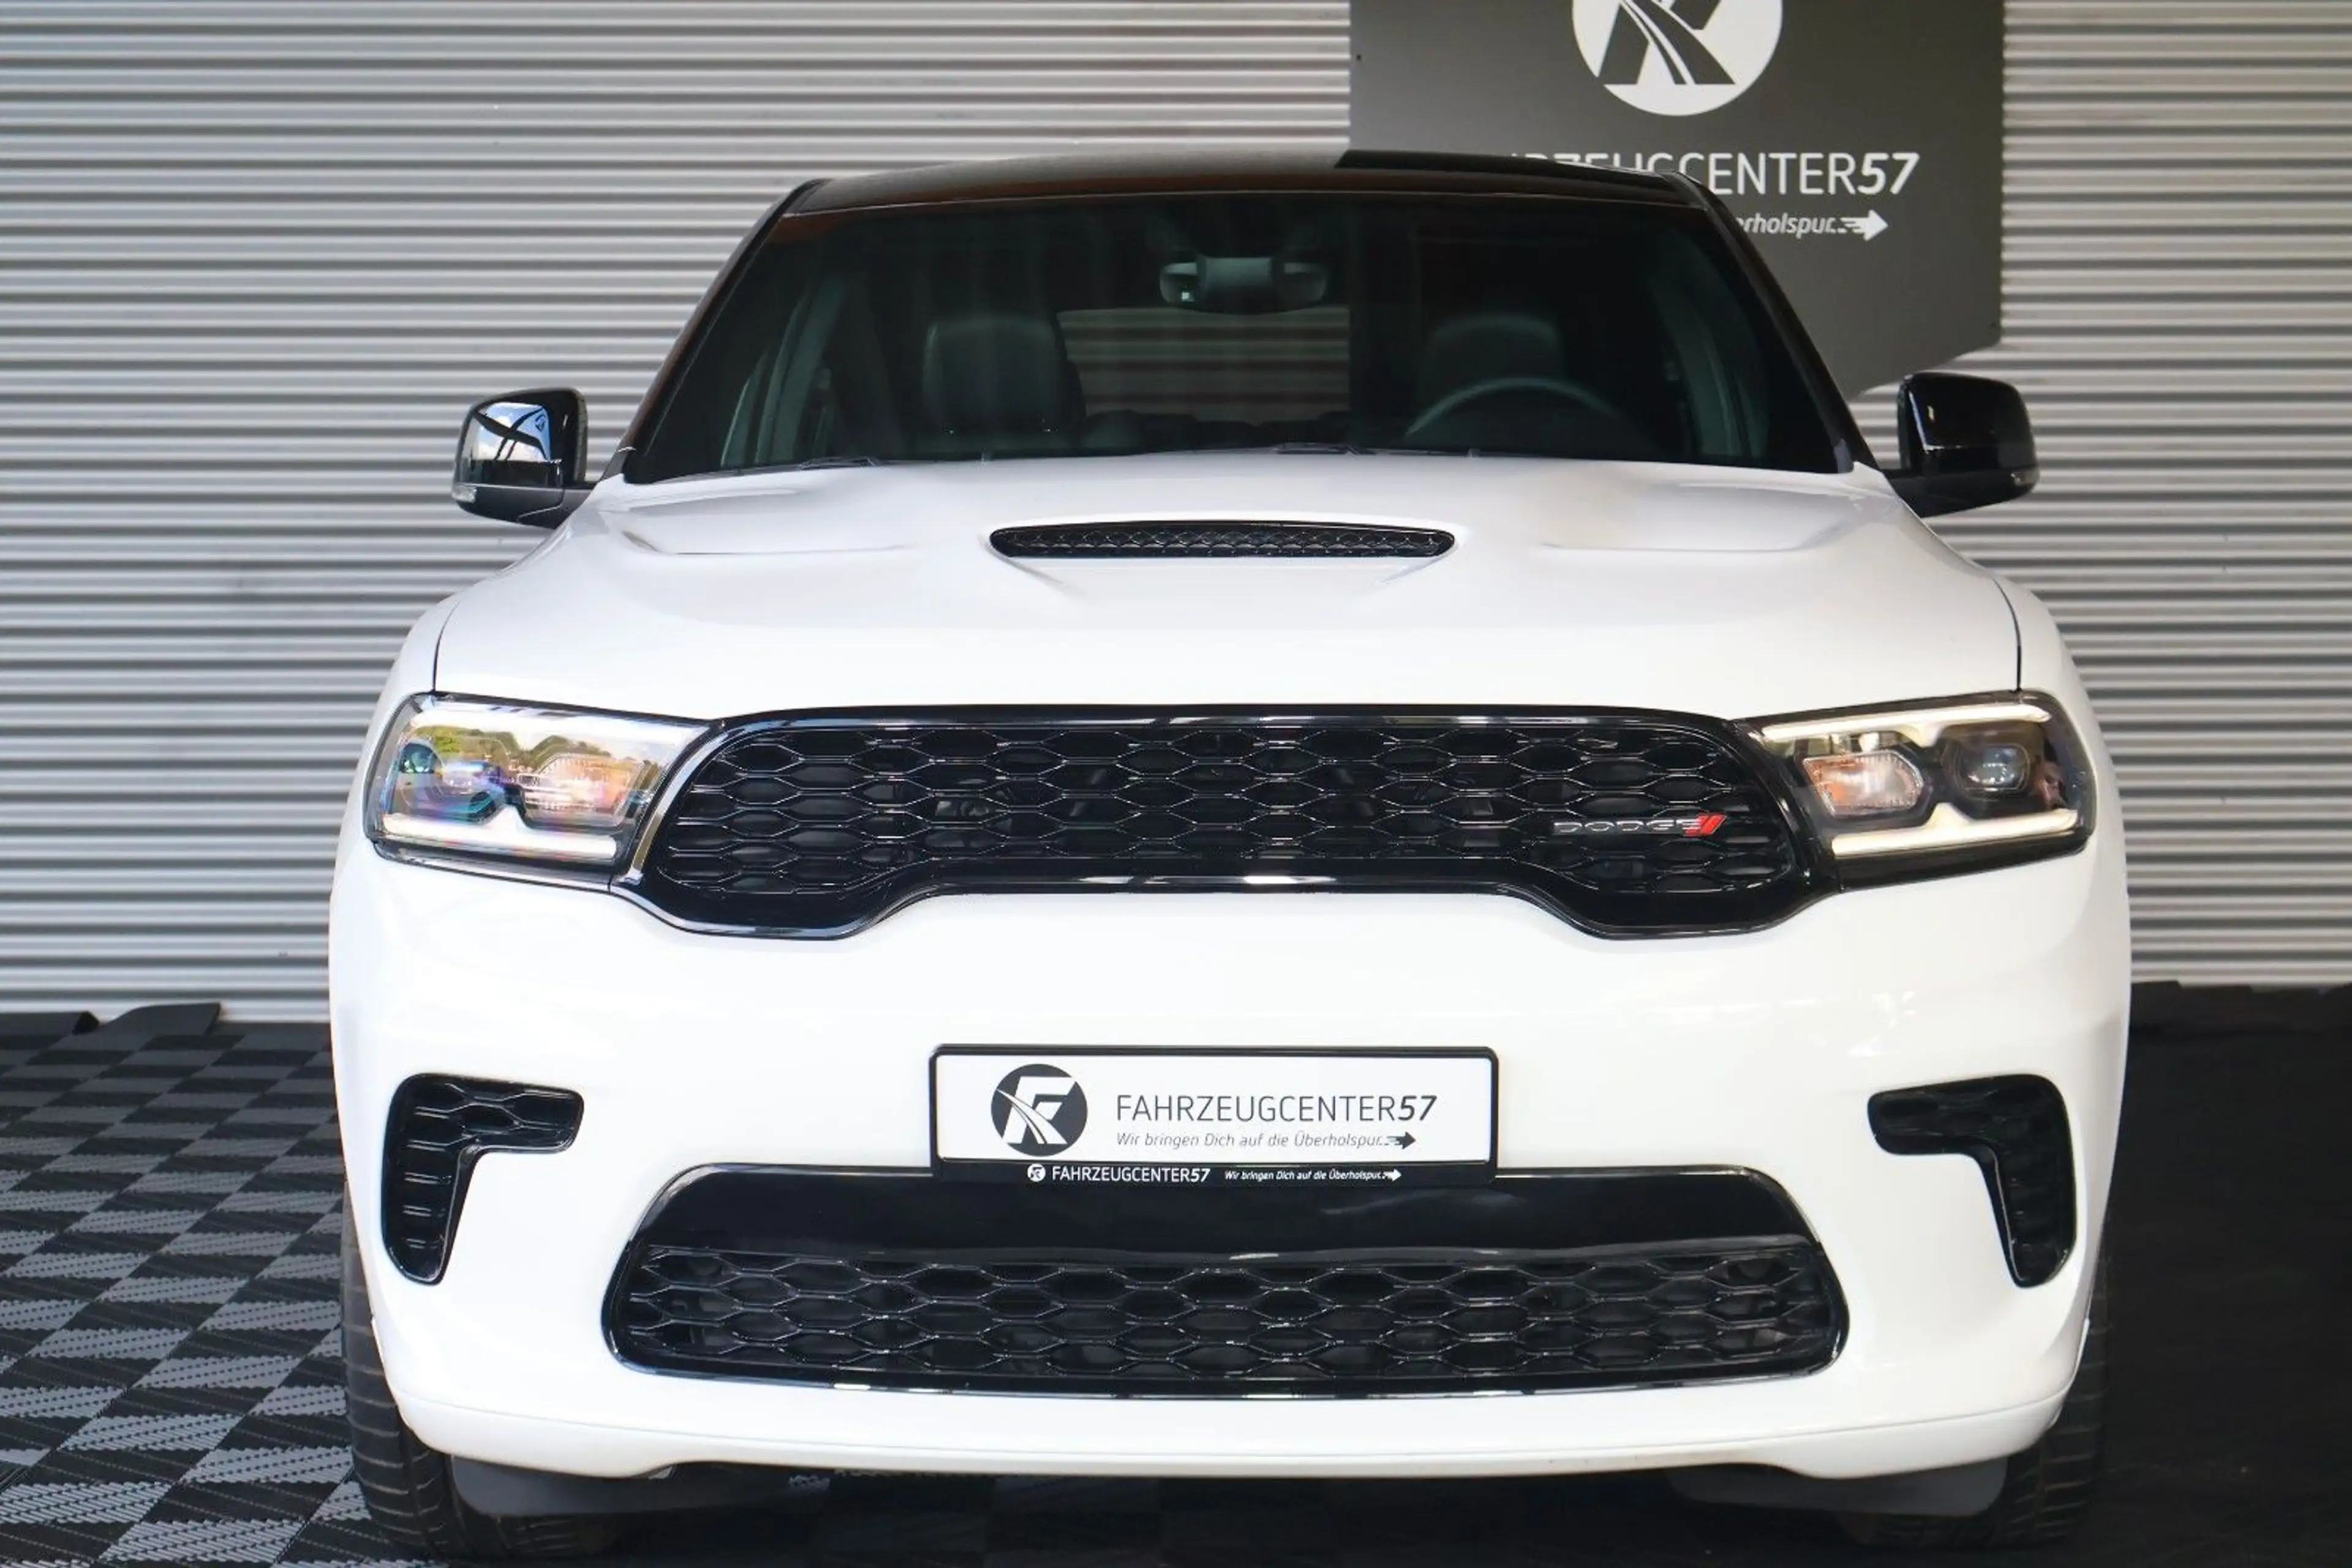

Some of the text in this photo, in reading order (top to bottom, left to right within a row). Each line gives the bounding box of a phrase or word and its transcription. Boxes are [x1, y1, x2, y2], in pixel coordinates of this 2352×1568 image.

[1553, 819, 1702, 834] DODGE
[1117, 1095, 1438, 1122] FAHRZEUGCENTER57
[1117, 1133, 1140, 1146] Wir
[1145, 1133, 1199, 1150] bringen
[1204, 1133, 1235, 1147] Dich
[1239, 1133, 1264, 1147] auf
[1268, 1133, 1289, 1147] die
[1052, 1166, 1211, 1182] FAHRZEUGCENTER57
[1224, 1170, 1240, 1180] Wir
[1241, 1170, 1274, 1182] bringen
[1276, 1170, 1295, 1180] Dich
[1297, 1170, 1312, 1180] auf
[1313, 1170, 1327, 1180] die
